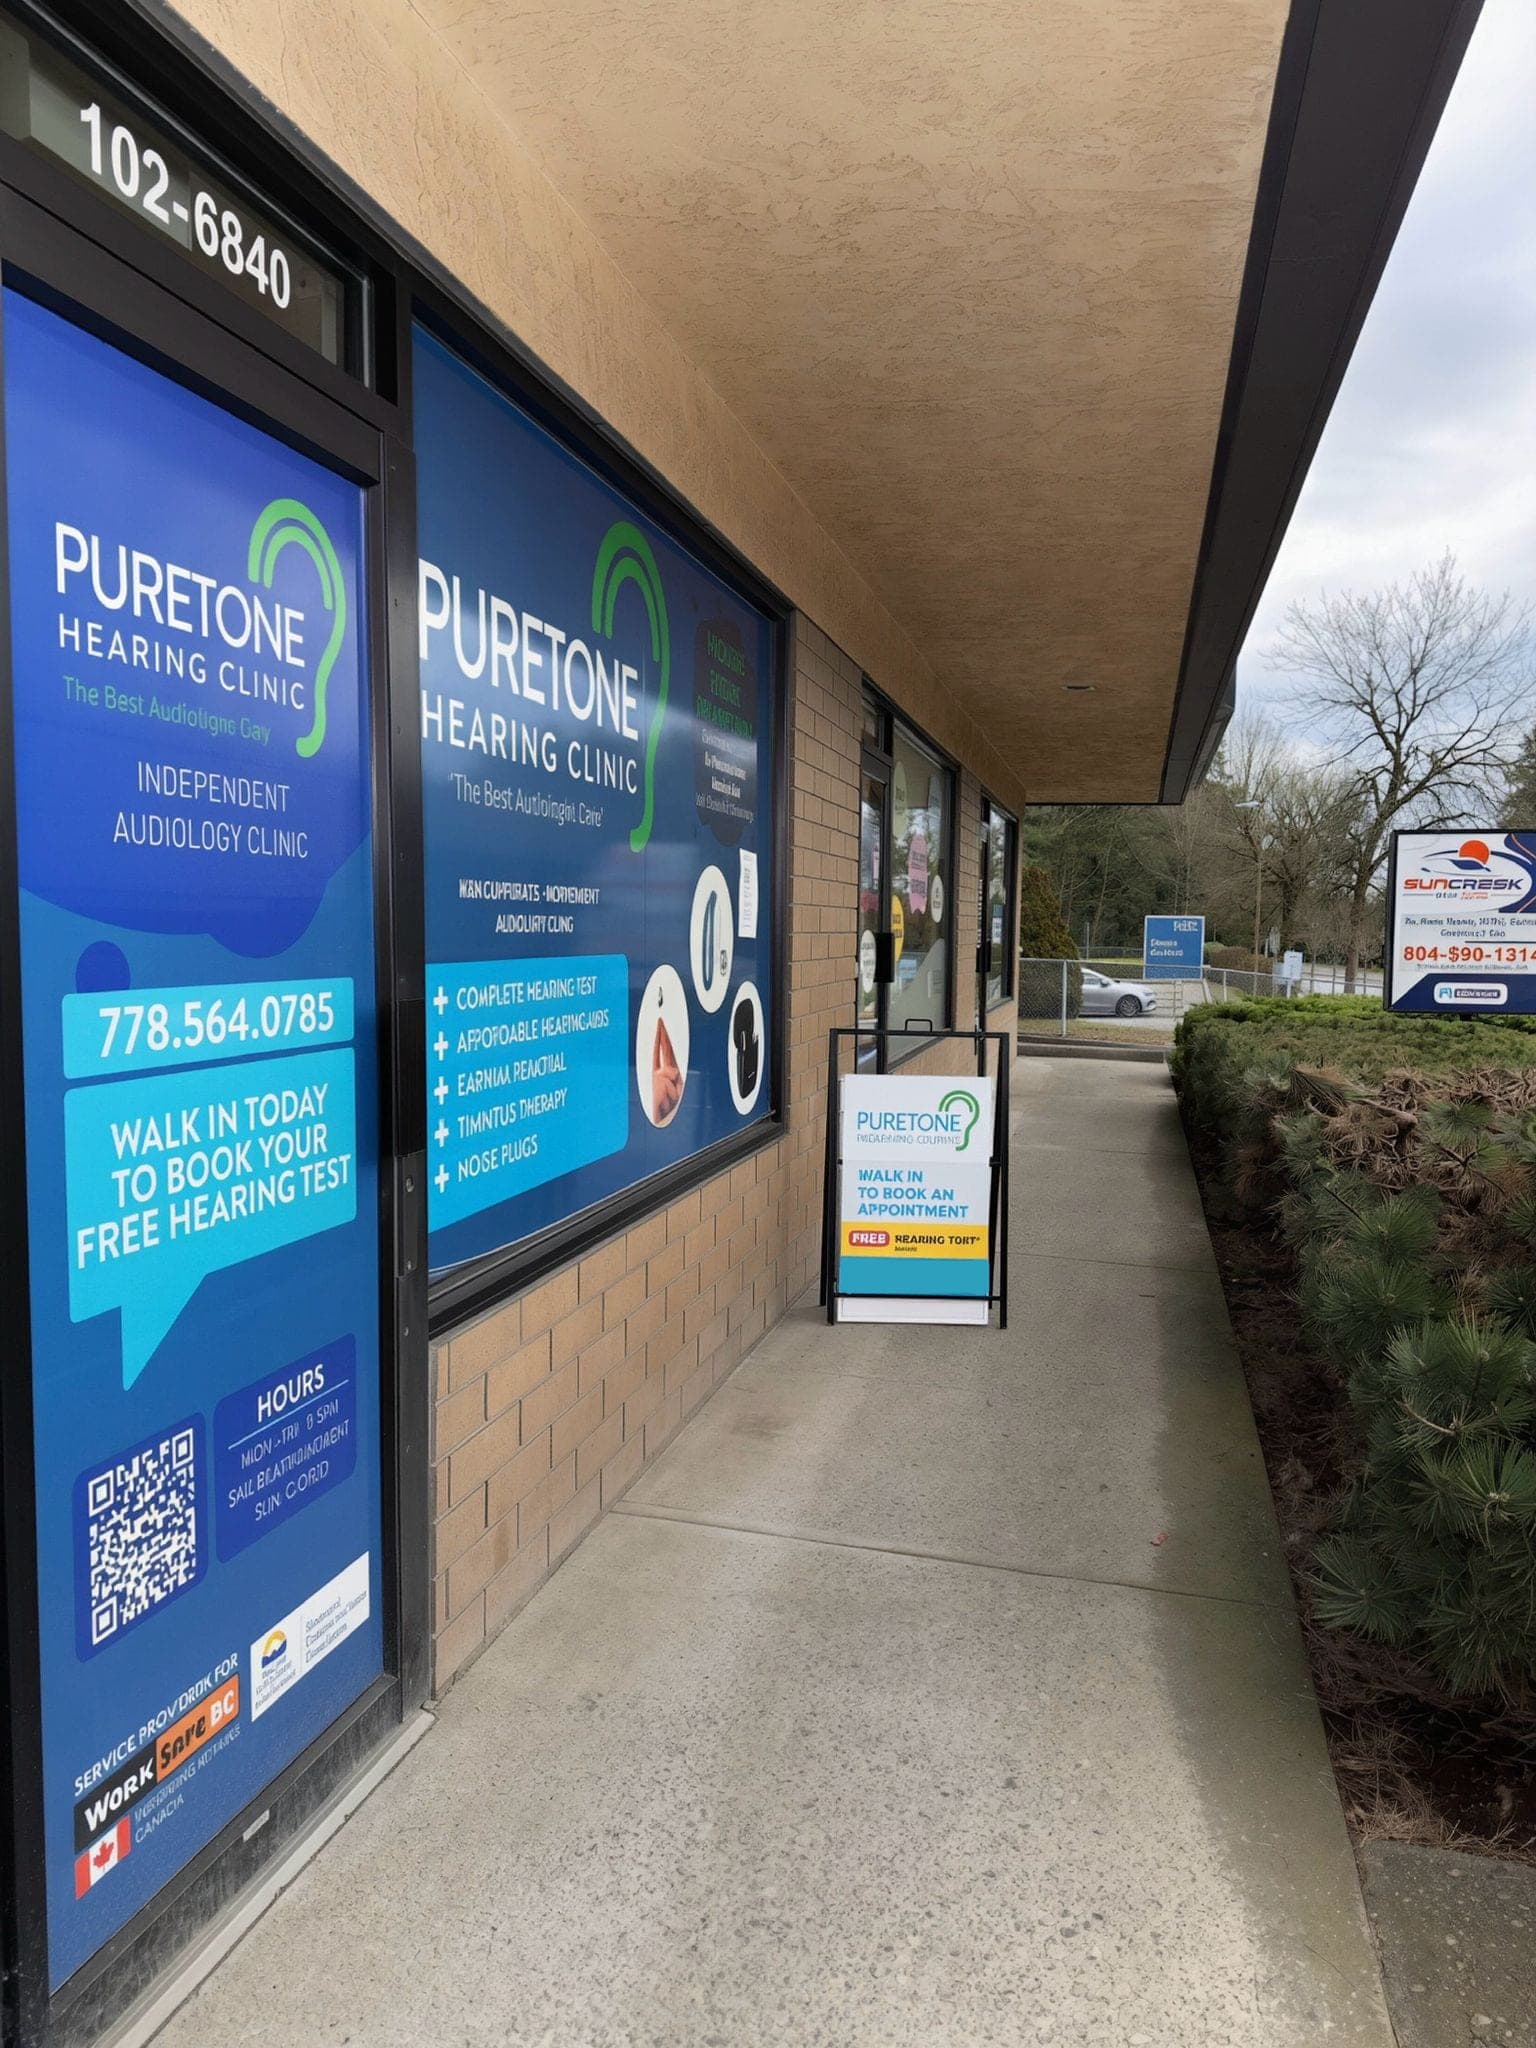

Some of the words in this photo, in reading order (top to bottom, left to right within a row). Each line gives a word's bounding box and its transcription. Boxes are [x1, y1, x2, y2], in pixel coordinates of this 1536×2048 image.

[80, 102, 291, 309] 102-6840
[55, 522, 305, 668] PURETONE
[59, 613, 207, 684] HEARING
[219, 661, 305, 710] CLINIC
[418, 558, 639, 741] PURETONE
[63, 675, 99, 706] The
[104, 685, 145, 716] Best
[421, 690, 557, 772] HEARING
[568, 741, 639, 794] CLINIC
[137, 761, 290, 812] INDEPENDENT
[484, 780, 513, 812] Best
[113, 811, 242, 854] AUDIOLOGY
[247, 825, 308, 859] CLINIC
[99, 991, 334, 1058] 778.564.0785
[456, 982, 524, 1011] COMPLETE
[109, 1106, 201, 1160] WALK
[208, 1100, 238, 1140] IN
[245, 1083, 328, 1131] TODAY
[857, 1111, 961, 1132] PURETONE
[111, 1164, 157, 1208] TO
[167, 1139, 253, 1195] BOOK
[258, 1123, 328, 1169] YOUR
[857, 1186, 879, 1200] TO
[882, 1187, 928, 1200] BOOK
[931, 1188, 954, 1201] AN
[858, 1168, 904, 1183] WALK
[907, 1170, 924, 1183] IN
[77, 1208, 161, 1270] FREE
[169, 1169, 296, 1240] HEARING
[299, 1153, 352, 1197] TEST
[851, 1232, 887, 1245] FREE
[857, 1203, 969, 1219] APPOINTMENT
[257, 1363, 325, 1423] HOURS
[73, 1735, 136, 1797] SERVICE
[214, 1652, 239, 1684] FOR
[84, 1756, 155, 1833] WORK
[210, 1689, 235, 1728] BC
